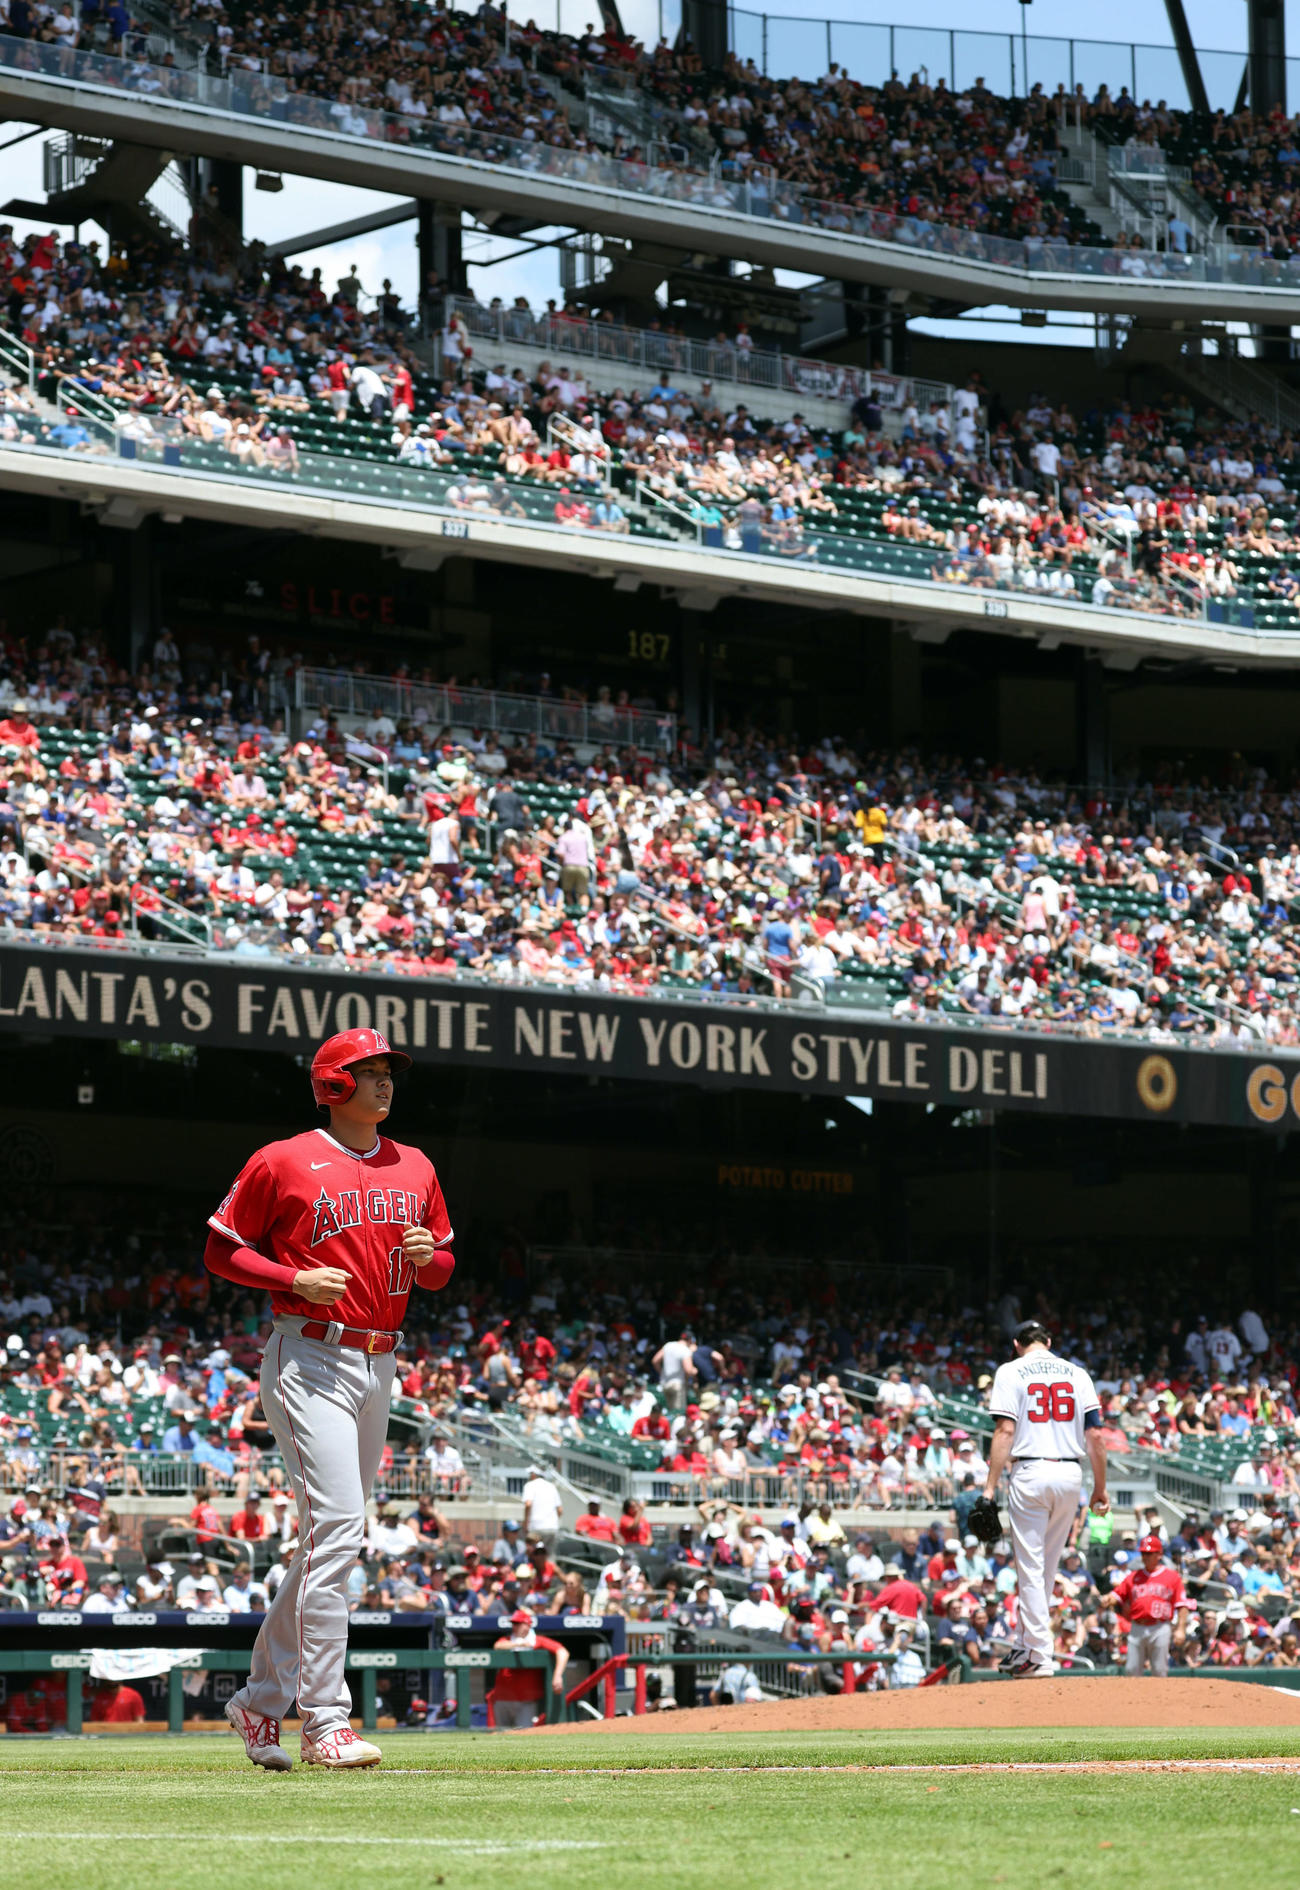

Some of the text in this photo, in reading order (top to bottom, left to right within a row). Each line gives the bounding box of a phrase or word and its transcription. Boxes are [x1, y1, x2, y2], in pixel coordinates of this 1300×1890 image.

[280, 582, 396, 624] SLICE
[628, 629, 671, 661] 187
[237, 983, 493, 1053] FAVORITE
[514, 1005, 621, 1063] NEW
[638, 1017, 772, 1076] YORK
[791, 1032, 930, 1090] STYLE
[949, 1045, 1048, 1099] DELI
[1246, 1063, 1300, 1123] G
[1017, 1361, 1074, 1380] ANDERSON
[1027, 1381, 1075, 1424] 36
[37, 1612, 83, 1626] GEICO
[112, 1612, 158, 1626] GEICO
[186, 1612, 230, 1626] GEICO
[349, 1611, 392, 1625] GEICO
[563, 1614, 603, 1628] GEICO
[51, 1654, 93, 1668] GEIC
[350, 1652, 397, 1667] GEICO
[444, 1652, 491, 1667] GEICO
